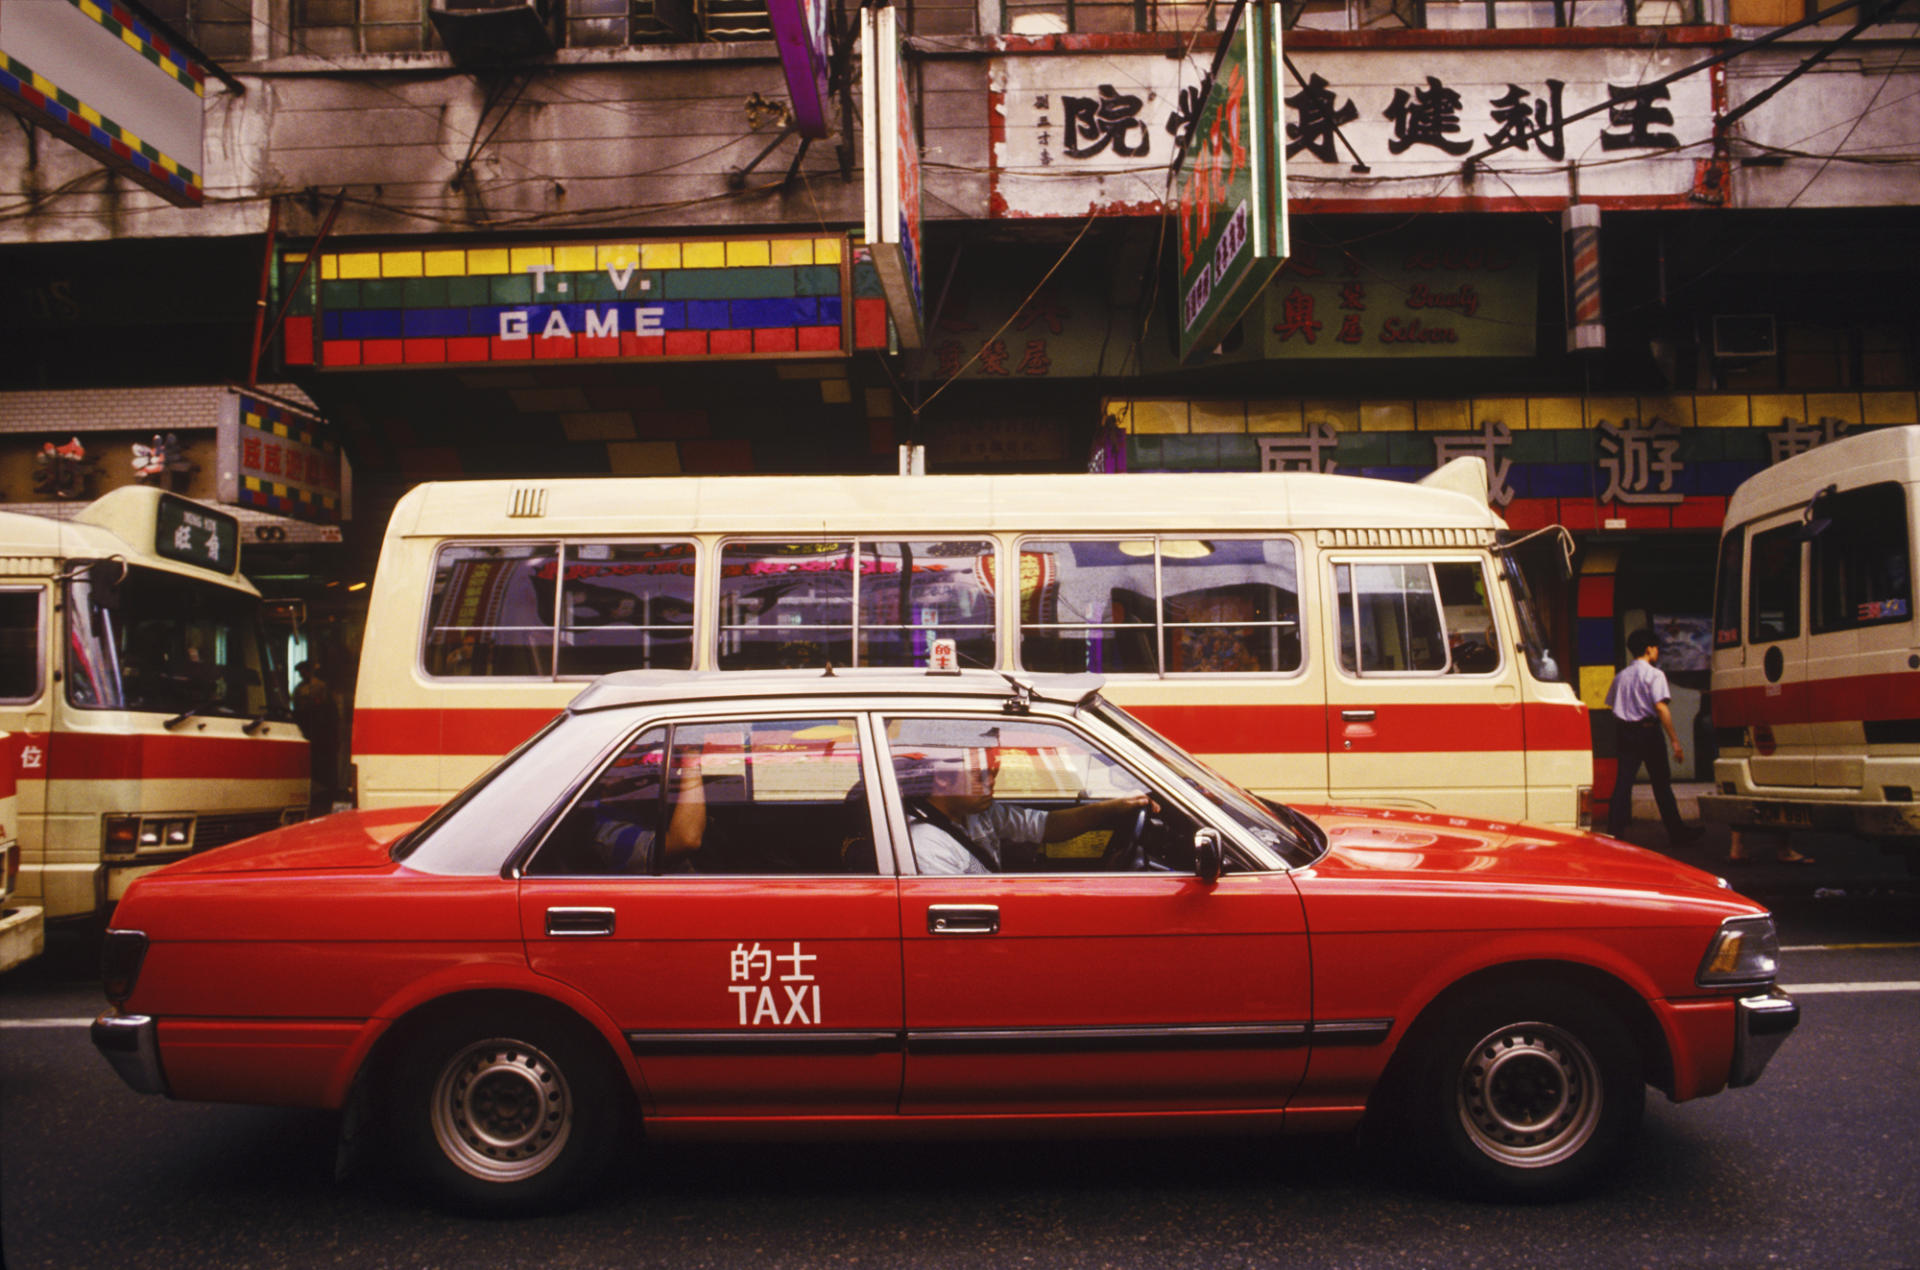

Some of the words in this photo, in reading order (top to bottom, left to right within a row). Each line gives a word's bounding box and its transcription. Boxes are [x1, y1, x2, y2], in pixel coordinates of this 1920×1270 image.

[528, 264, 568, 293] T.
[606, 262, 652, 291] V.
[500, 307, 665, 341] GAME
[935, 644, 951, 668] 的士
[730, 941, 817, 981] 的士
[728, 985, 821, 1025] TAXI
